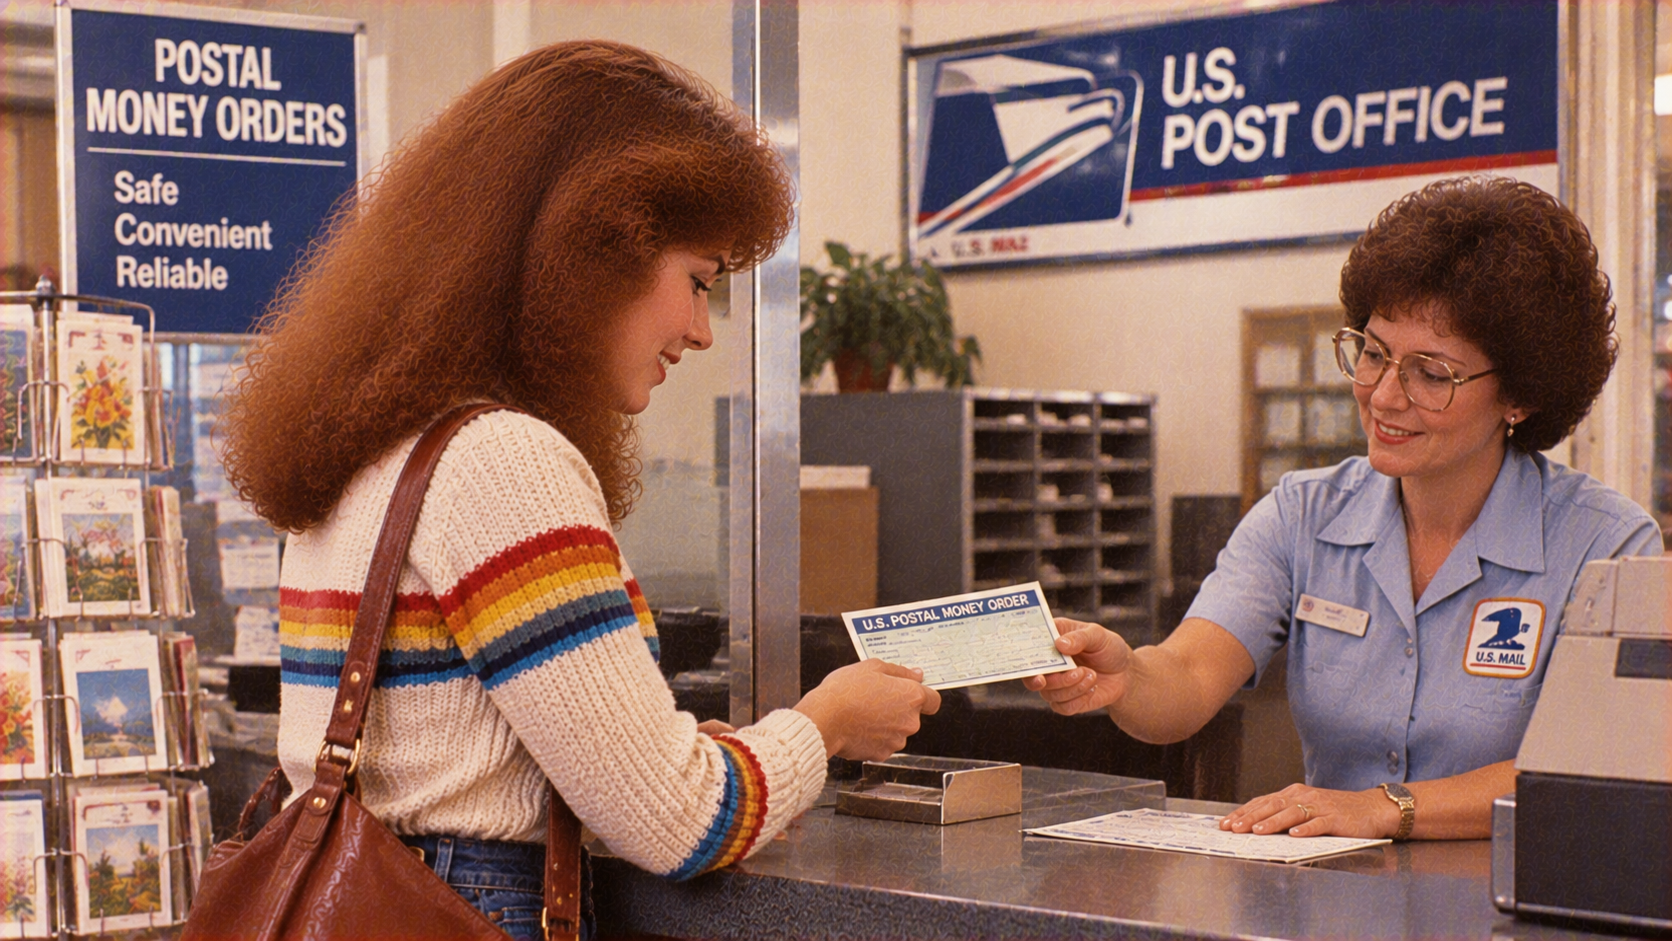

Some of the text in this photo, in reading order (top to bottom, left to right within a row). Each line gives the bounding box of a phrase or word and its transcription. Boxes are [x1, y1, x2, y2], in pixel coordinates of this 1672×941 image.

[155, 39, 281, 91] POSTAL
[1162, 47, 1245, 106] U.S.
[86, 88, 347, 147] MONEY ORDERS
[1162, 77, 1507, 168] POST OFFICE
[114, 170, 178, 205] Safe
[115, 213, 272, 250] Convenient
[117, 256, 228, 290] Reliable
[862, 617, 890, 631] U.S.
[891, 608, 940, 627] POSTAL
[942, 600, 984, 618] MONEY
[988, 593, 1029, 611] ORDER
[1475, 651, 1526, 665] U.S. MAIL
